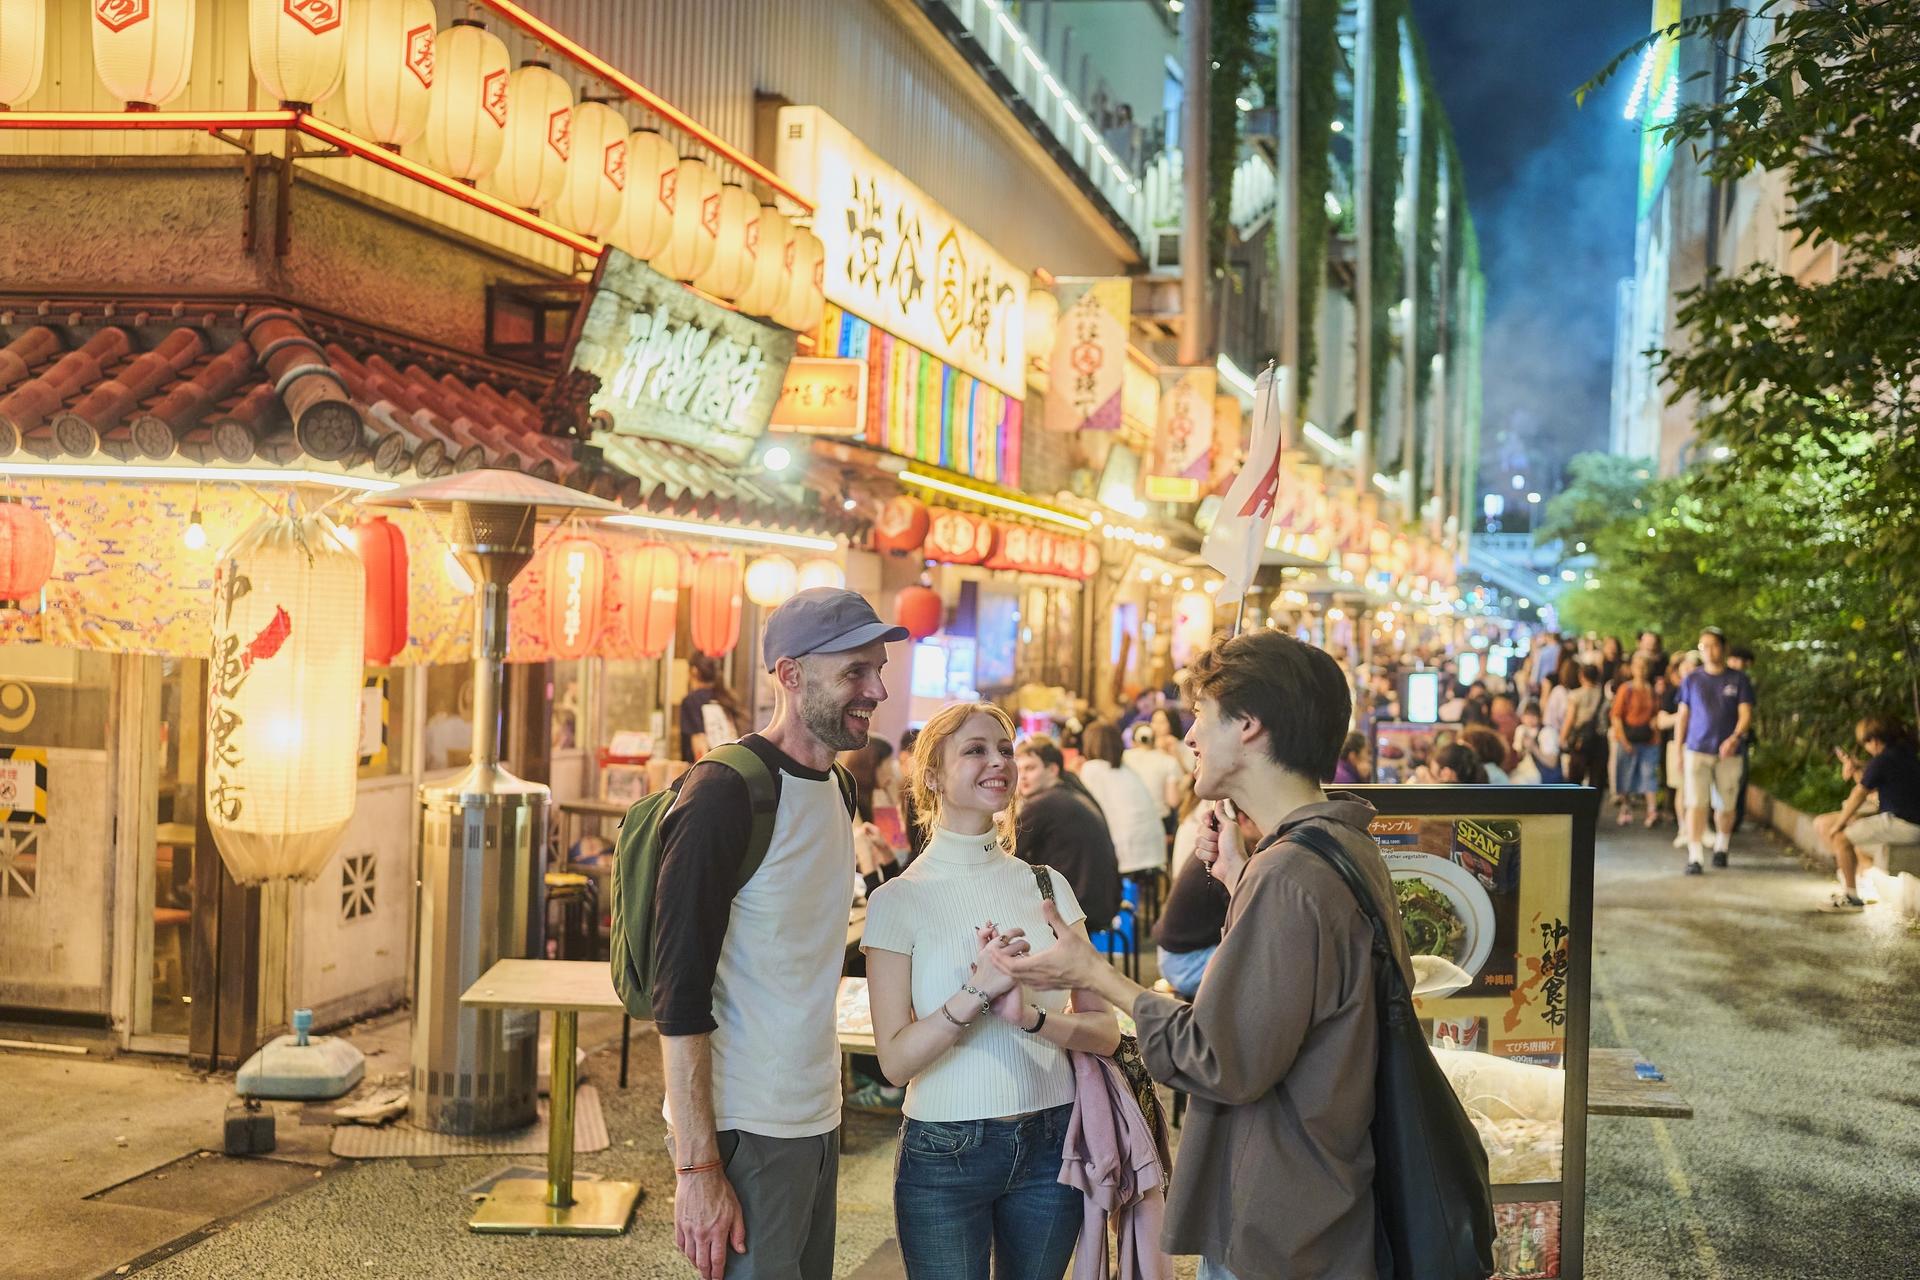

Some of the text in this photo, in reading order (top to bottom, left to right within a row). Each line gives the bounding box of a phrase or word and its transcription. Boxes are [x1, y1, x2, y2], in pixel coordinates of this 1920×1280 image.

[1457, 821, 1502, 859] SPAM
[1485, 974, 1514, 986] 沖縄県
[1540, 917, 1569, 1034] 沖縄食市
[1505, 1040, 1557, 1053] てびち唐揚げ
